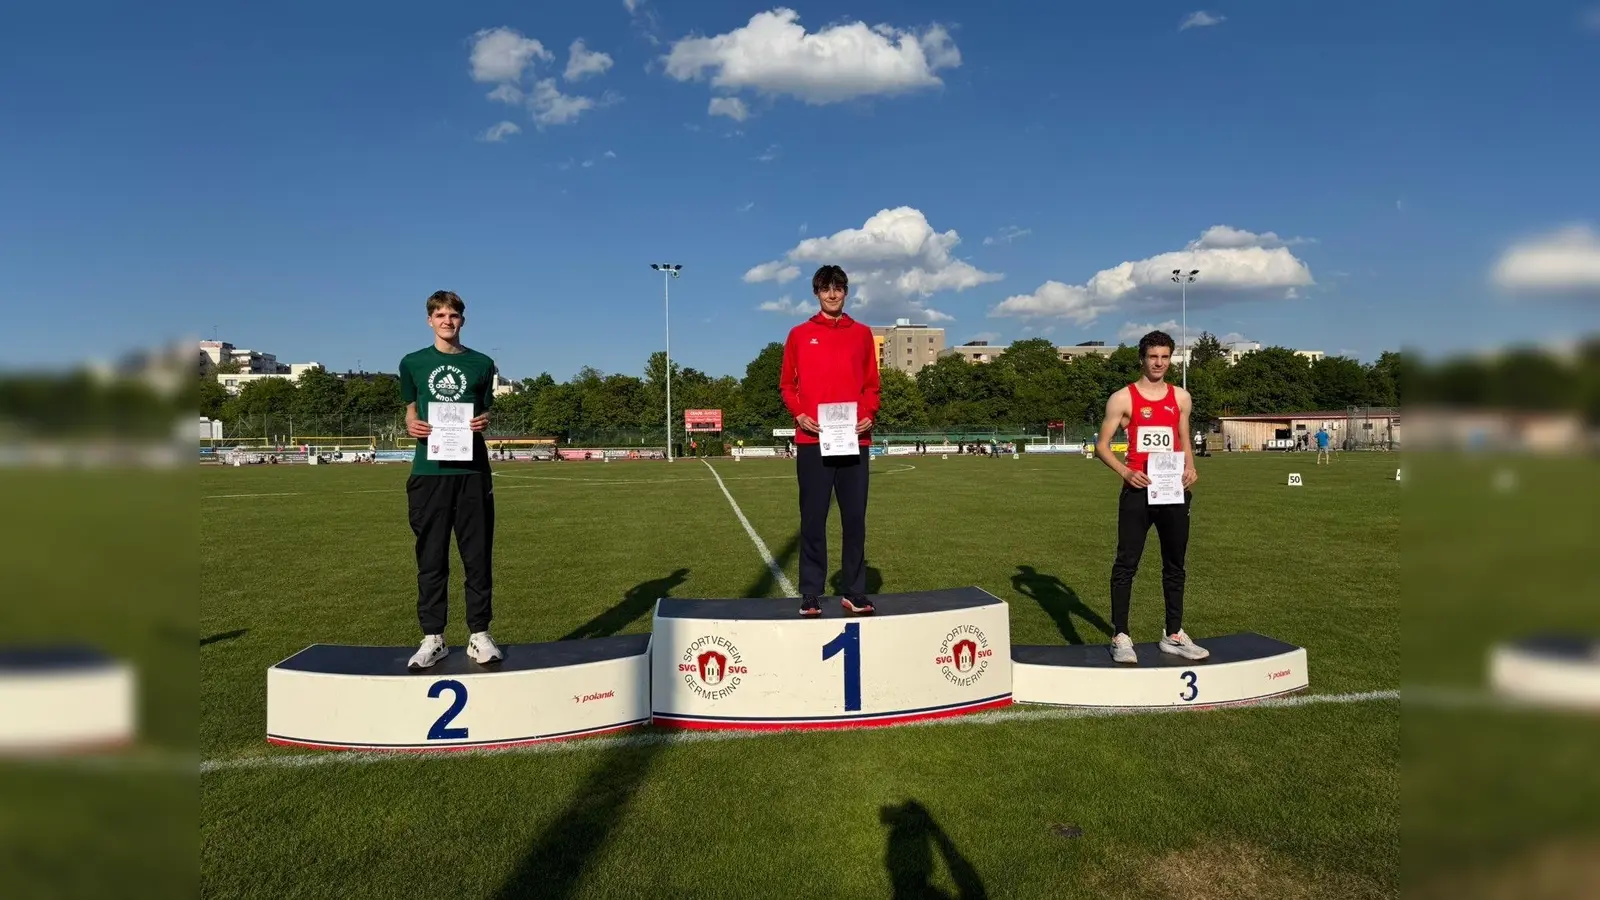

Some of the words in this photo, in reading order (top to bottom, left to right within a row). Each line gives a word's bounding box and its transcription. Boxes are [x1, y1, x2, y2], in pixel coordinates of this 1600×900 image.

[447, 365, 461, 374] PUT
[428, 365, 445, 395] WORKOUT
[459, 373, 468, 395] WORK
[435, 393, 454, 402] YOUR
[1142, 433, 1170, 447] 530
[1289, 475, 1301, 484] 50
[940, 624, 989, 655] SPORTVEREIN
[683, 635, 743, 664] SPORTVEREIN
[977, 649, 993, 659] SVG
[678, 663, 697, 673] SVG
[822, 622, 861, 712] 1
[935, 655, 953, 665] SVG
[727, 665, 748, 674] SVG
[941, 659, 988, 687] GERMERING
[684, 674, 742, 700] GERMERING
[1179, 670, 1199, 702] 3
[582, 689, 615, 703] polanik
[426, 679, 469, 741] 2
